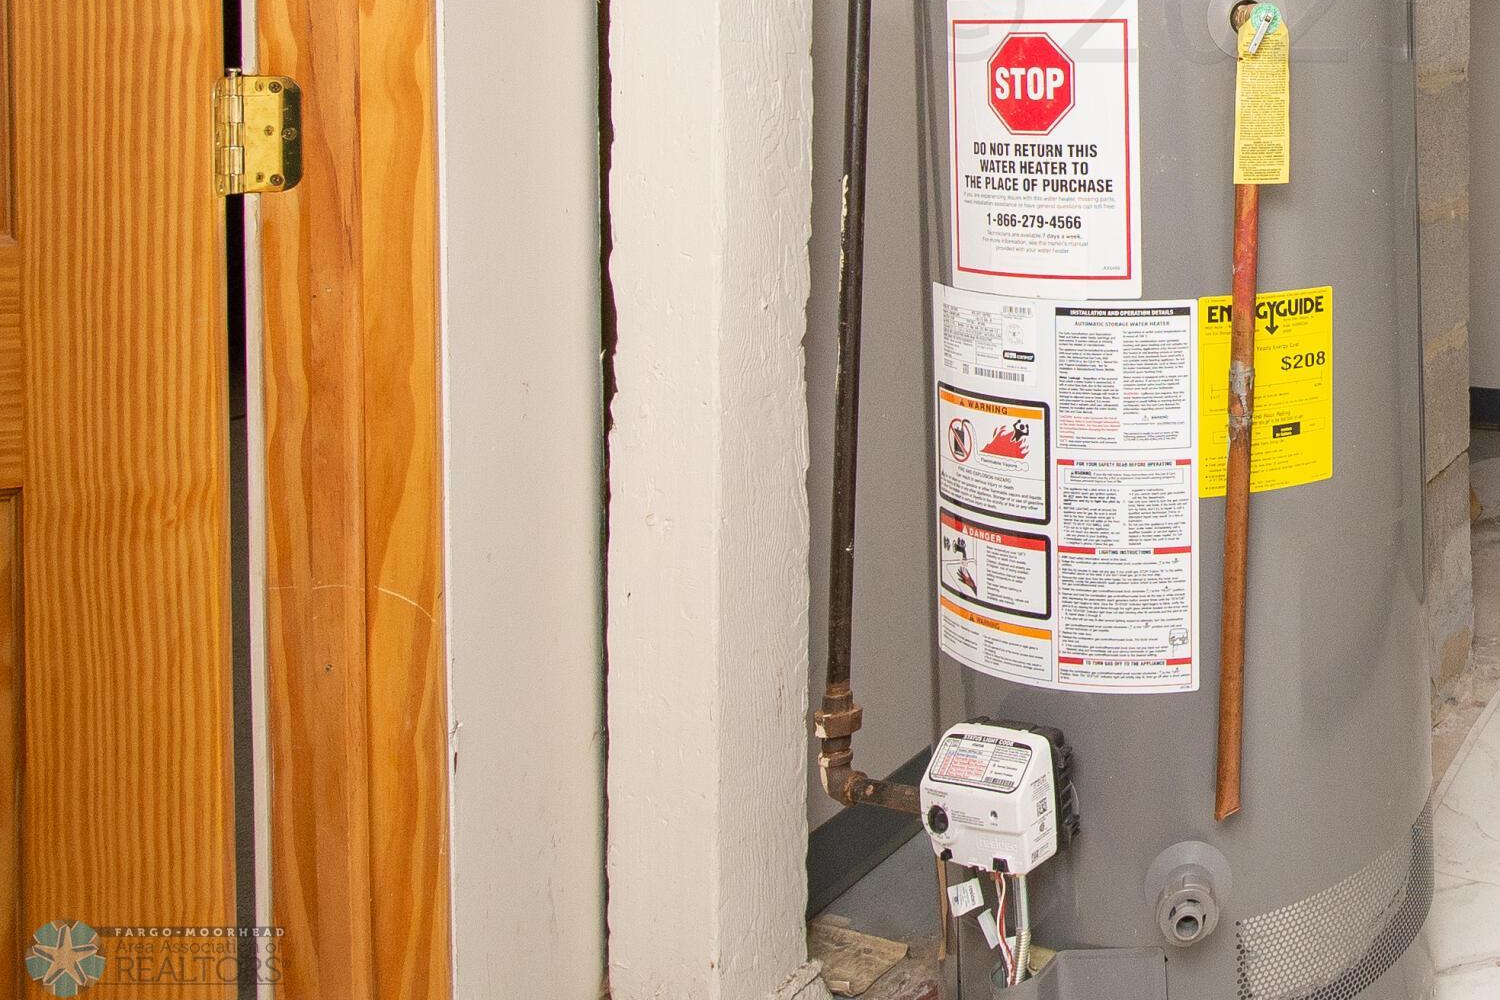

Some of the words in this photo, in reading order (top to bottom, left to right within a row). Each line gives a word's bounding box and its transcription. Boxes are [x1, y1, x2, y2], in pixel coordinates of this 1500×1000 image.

[995, 66, 1065, 104] STOP
[974, 142, 986, 155] DO
[990, 143, 1010, 156] NOT
[1015, 144, 1063, 157] RETURN
[1068, 144, 1098, 158] THIS
[980, 160, 1016, 174] WATER
[1020, 161, 1067, 175] HEATER
[1072, 162, 1088, 175] TO
[965, 175, 982, 189] THE
[985, 176, 1018, 191] PLACE
[1023, 178, 1038, 192] OF
[1042, 179, 1113, 192] PURCHASE
[986, 213, 1082, 229] 1-866-279-4566
[1207, 296, 1324, 324] ENGYGUIDE
[1281, 350, 1326, 371] $208
[968, 399, 1008, 415] WARNING
[969, 528, 1002, 544] DANGER
